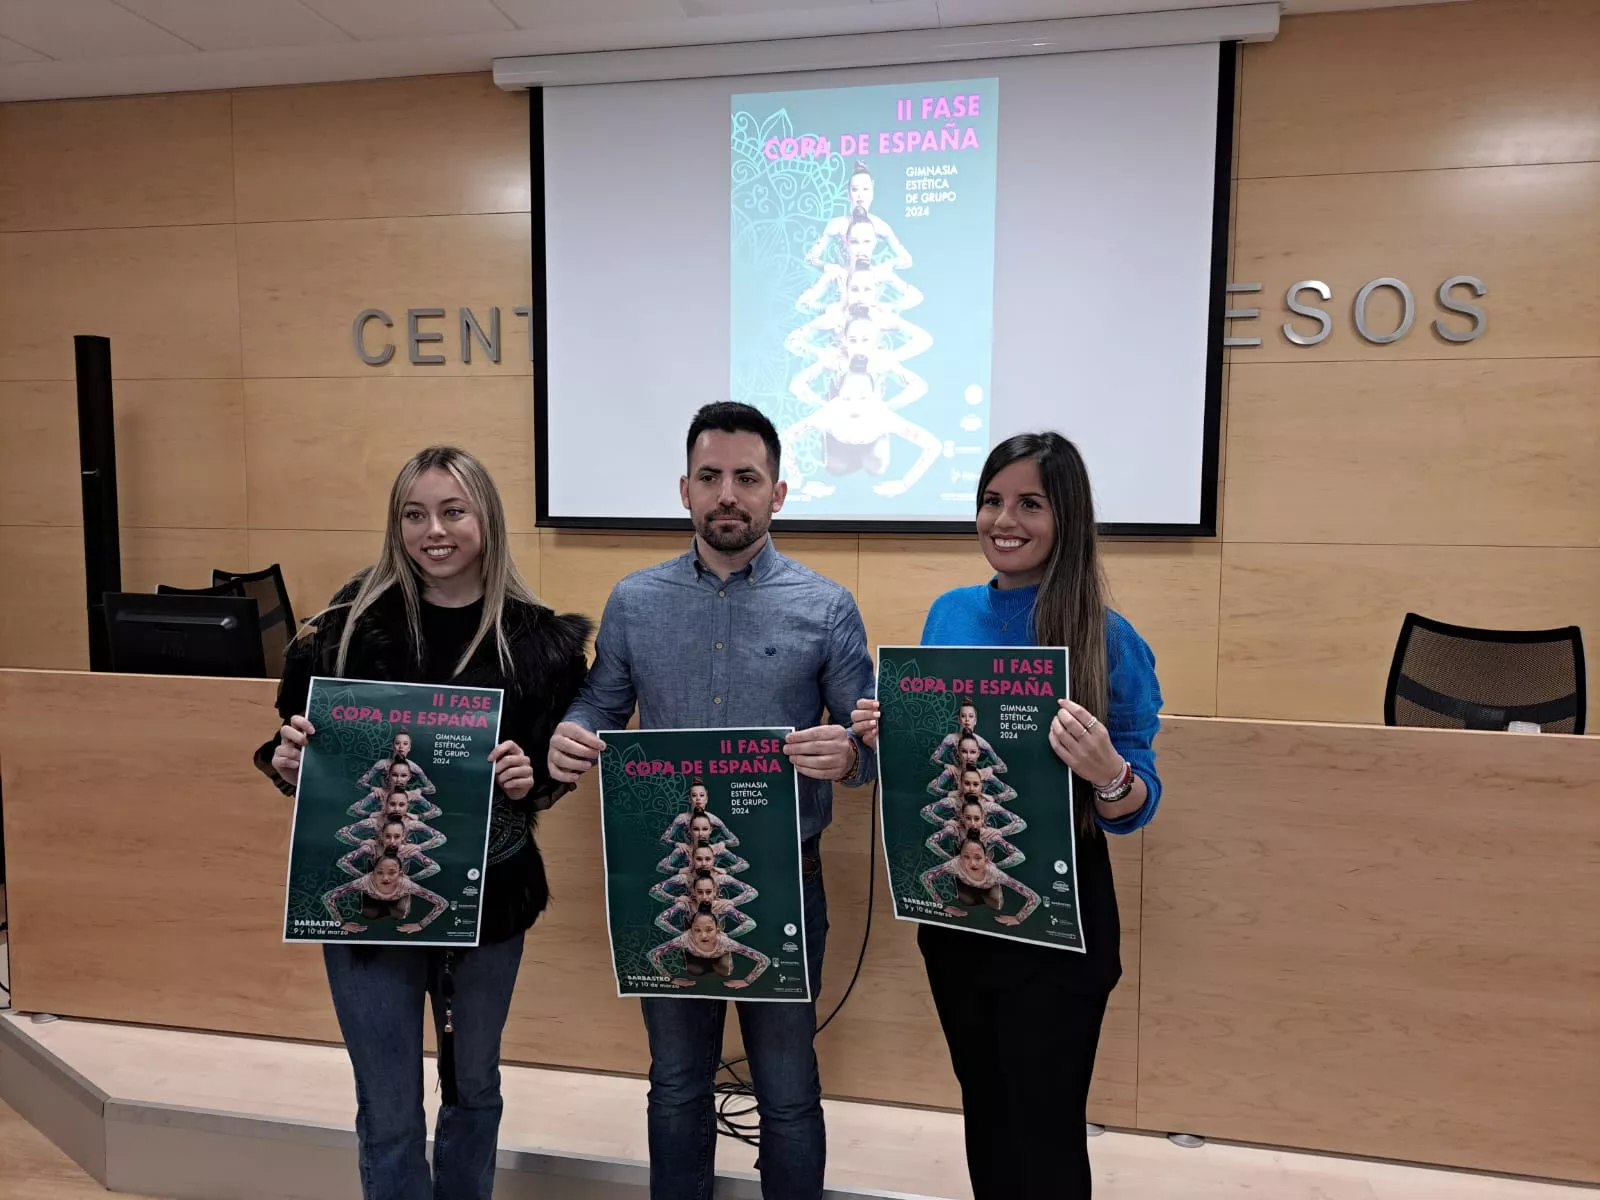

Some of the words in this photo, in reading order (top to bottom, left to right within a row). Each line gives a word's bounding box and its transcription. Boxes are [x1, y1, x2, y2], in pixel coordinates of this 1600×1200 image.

[897, 100, 912, 121] II
[922, 94, 980, 119] FASE
[763, 134, 832, 161] COPA
[840, 134, 870, 156] DE
[879, 121, 979, 154] ESPAÑA
[905, 164, 958, 177] GIMNASIA
[905, 176, 949, 191] ESTÉTICA
[905, 194, 918, 204] DE
[920, 191, 957, 203] GRUPO
[904, 206, 930, 218] 2024
[993, 658, 1004, 674] II
[1010, 659, 1054, 674] FASE
[900, 677, 946, 692] COPA
[953, 679, 974, 694] DE
[980, 676, 1054, 696] ESPAÑA
[432, 693, 443, 708] II
[450, 694, 492, 710] FASE
[1000, 704, 1038, 712] GIMNASIA
[332, 705, 382, 723] COPA
[389, 709, 411, 724] DE
[417, 711, 488, 728] ESPAÑA
[1000, 713, 1032, 722] ESTÉTICA
[1012, 722, 1038, 731] GRUPO
[435, 733, 472, 742] GIMNASIA
[434, 740, 466, 750] ESTÉTICA
[720, 740, 732, 754] II
[738, 739, 780, 754] FASE
[433, 749, 444, 757] DE
[444, 750, 470, 758] GRUPO
[432, 757, 450, 765] 2024
[625, 760, 675, 776] COPA
[681, 760, 703, 774] DE
[709, 755, 782, 774] ESPAÑA
[730, 788, 762, 798] ESTÉTICA
[294, 920, 342, 928] BARBASTRO
